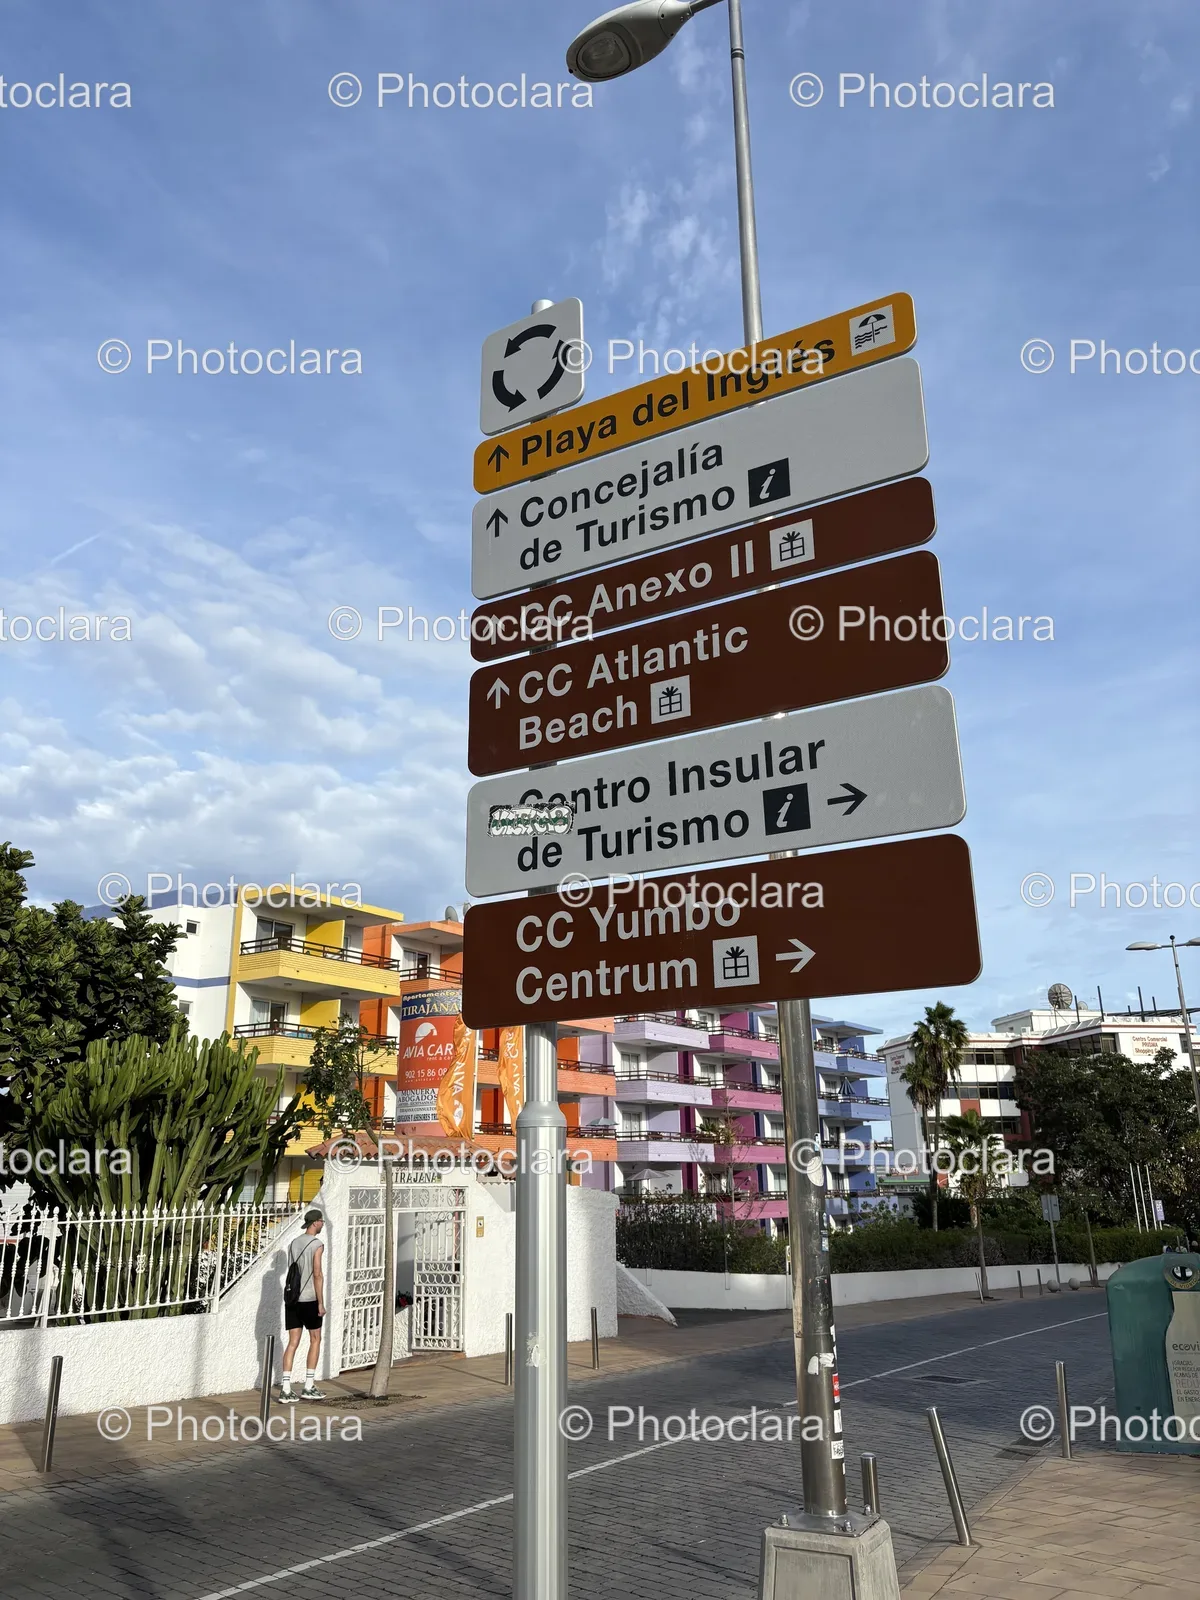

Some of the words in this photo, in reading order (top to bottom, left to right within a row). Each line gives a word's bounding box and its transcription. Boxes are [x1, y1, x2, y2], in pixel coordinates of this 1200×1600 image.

[521, 414, 617, 466] Playa
[632, 387, 689, 426] del
[707, 337, 836, 404] Inglés
[520, 442, 724, 528] Concejalía
[519, 536, 562, 570] de
[576, 487, 735, 553] Turismo
[519, 593, 573, 638] CC
[586, 562, 713, 620] Anexo
[730, 541, 755, 579] II
[519, 663, 573, 704] CC
[586, 623, 749, 690] Atlantic
[519, 699, 638, 750] Beach
[668, 739, 826, 797] Insular
[517, 836, 563, 872] de
[577, 807, 749, 862] Turismo
[516, 911, 573, 953] CC
[589, 893, 742, 943] Yumbo
[402, 1001, 459, 1017] TIRAJANA
[515, 956, 698, 1005] Centrum
[403, 1045, 425, 1060] AVIA
[427, 1043, 454, 1057] CAR
[405, 1070, 416, 1079] 902
[417, 1069, 425, 1078] 15
[426, 1068, 436, 1077] 86
[392, 1171, 436, 1184] IRAJANA
